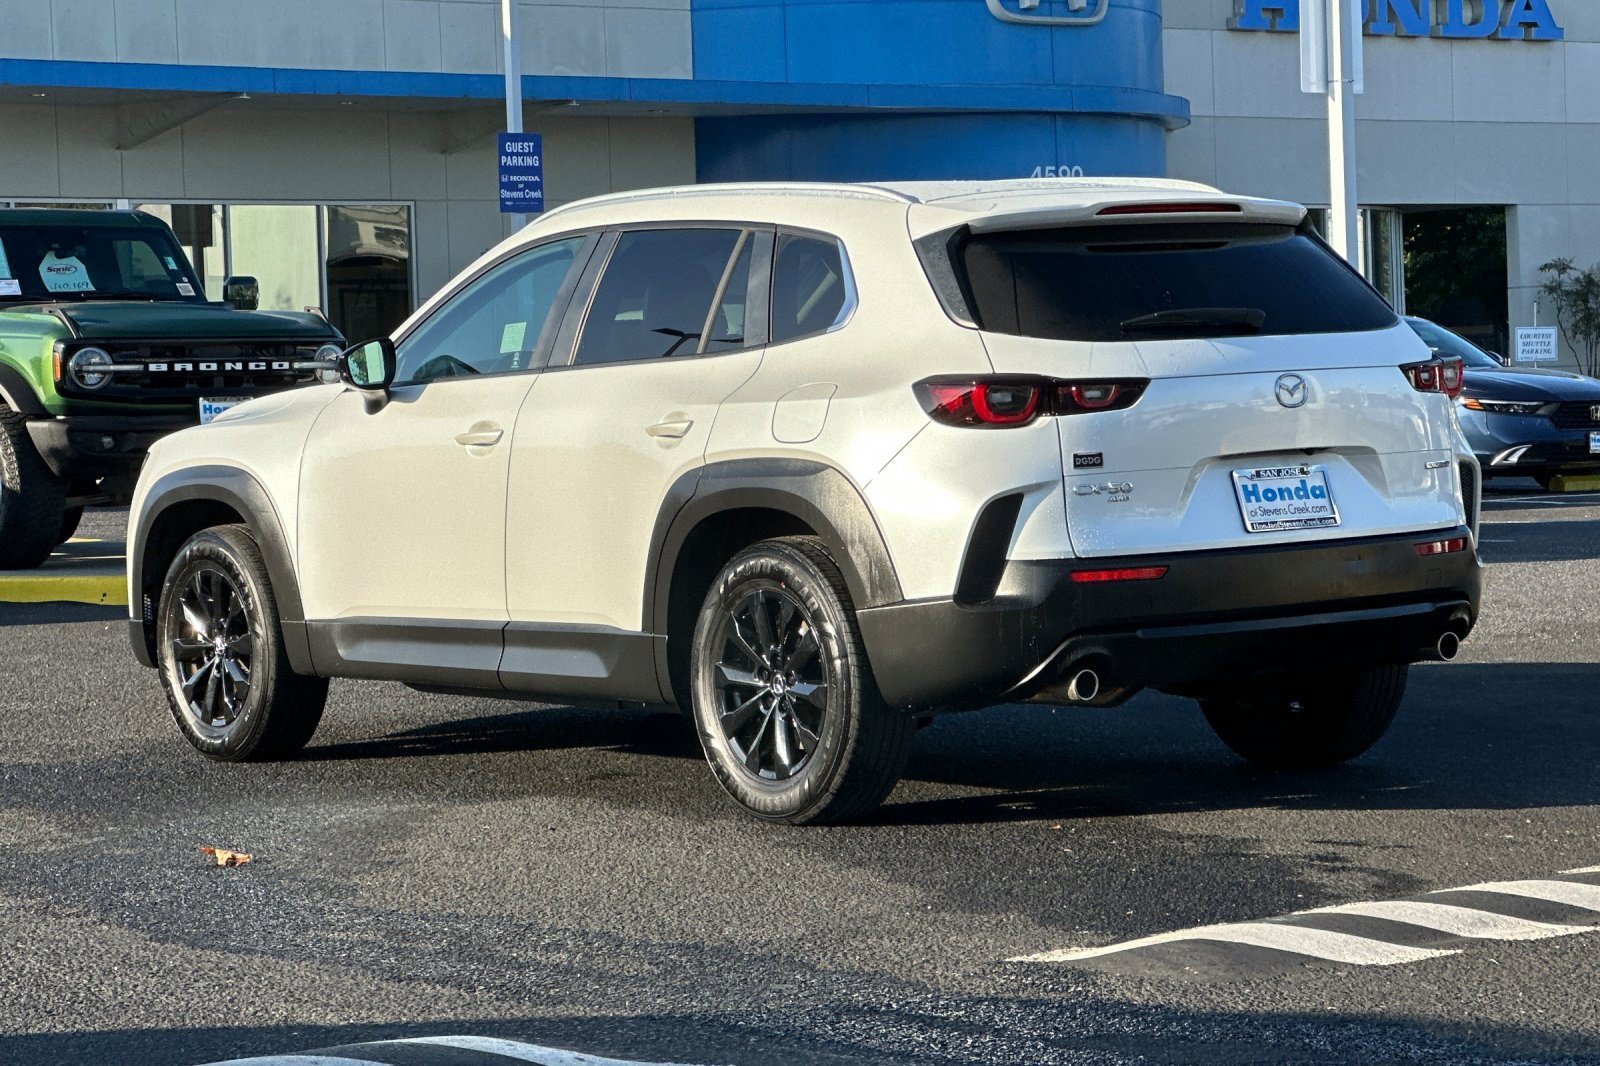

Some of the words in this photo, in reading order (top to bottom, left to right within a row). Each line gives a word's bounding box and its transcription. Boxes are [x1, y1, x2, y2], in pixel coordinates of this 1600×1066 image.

[1228, 0, 1564, 40] HNDA
[505, 141, 534, 153] GUEST
[501, 155, 540, 167] PARKING
[500, 188, 524, 199] Stevens
[524, 188, 542, 199] Creek
[148, 361, 290, 372] BRONCO
[1074, 456, 1101, 465] DGDG
[1260, 469, 1278, 478] SAN
[1279, 468, 1302, 477] JOSE
[1072, 481, 1133, 496] CX-50
[1241, 479, 1326, 503] Honda
[1107, 495, 1131, 503] AWD
[1250, 505, 1260, 517] of
[1259, 504, 1288, 517] Stevens
[1253, 518, 1335, 531] HondaofStevensCreek.com
